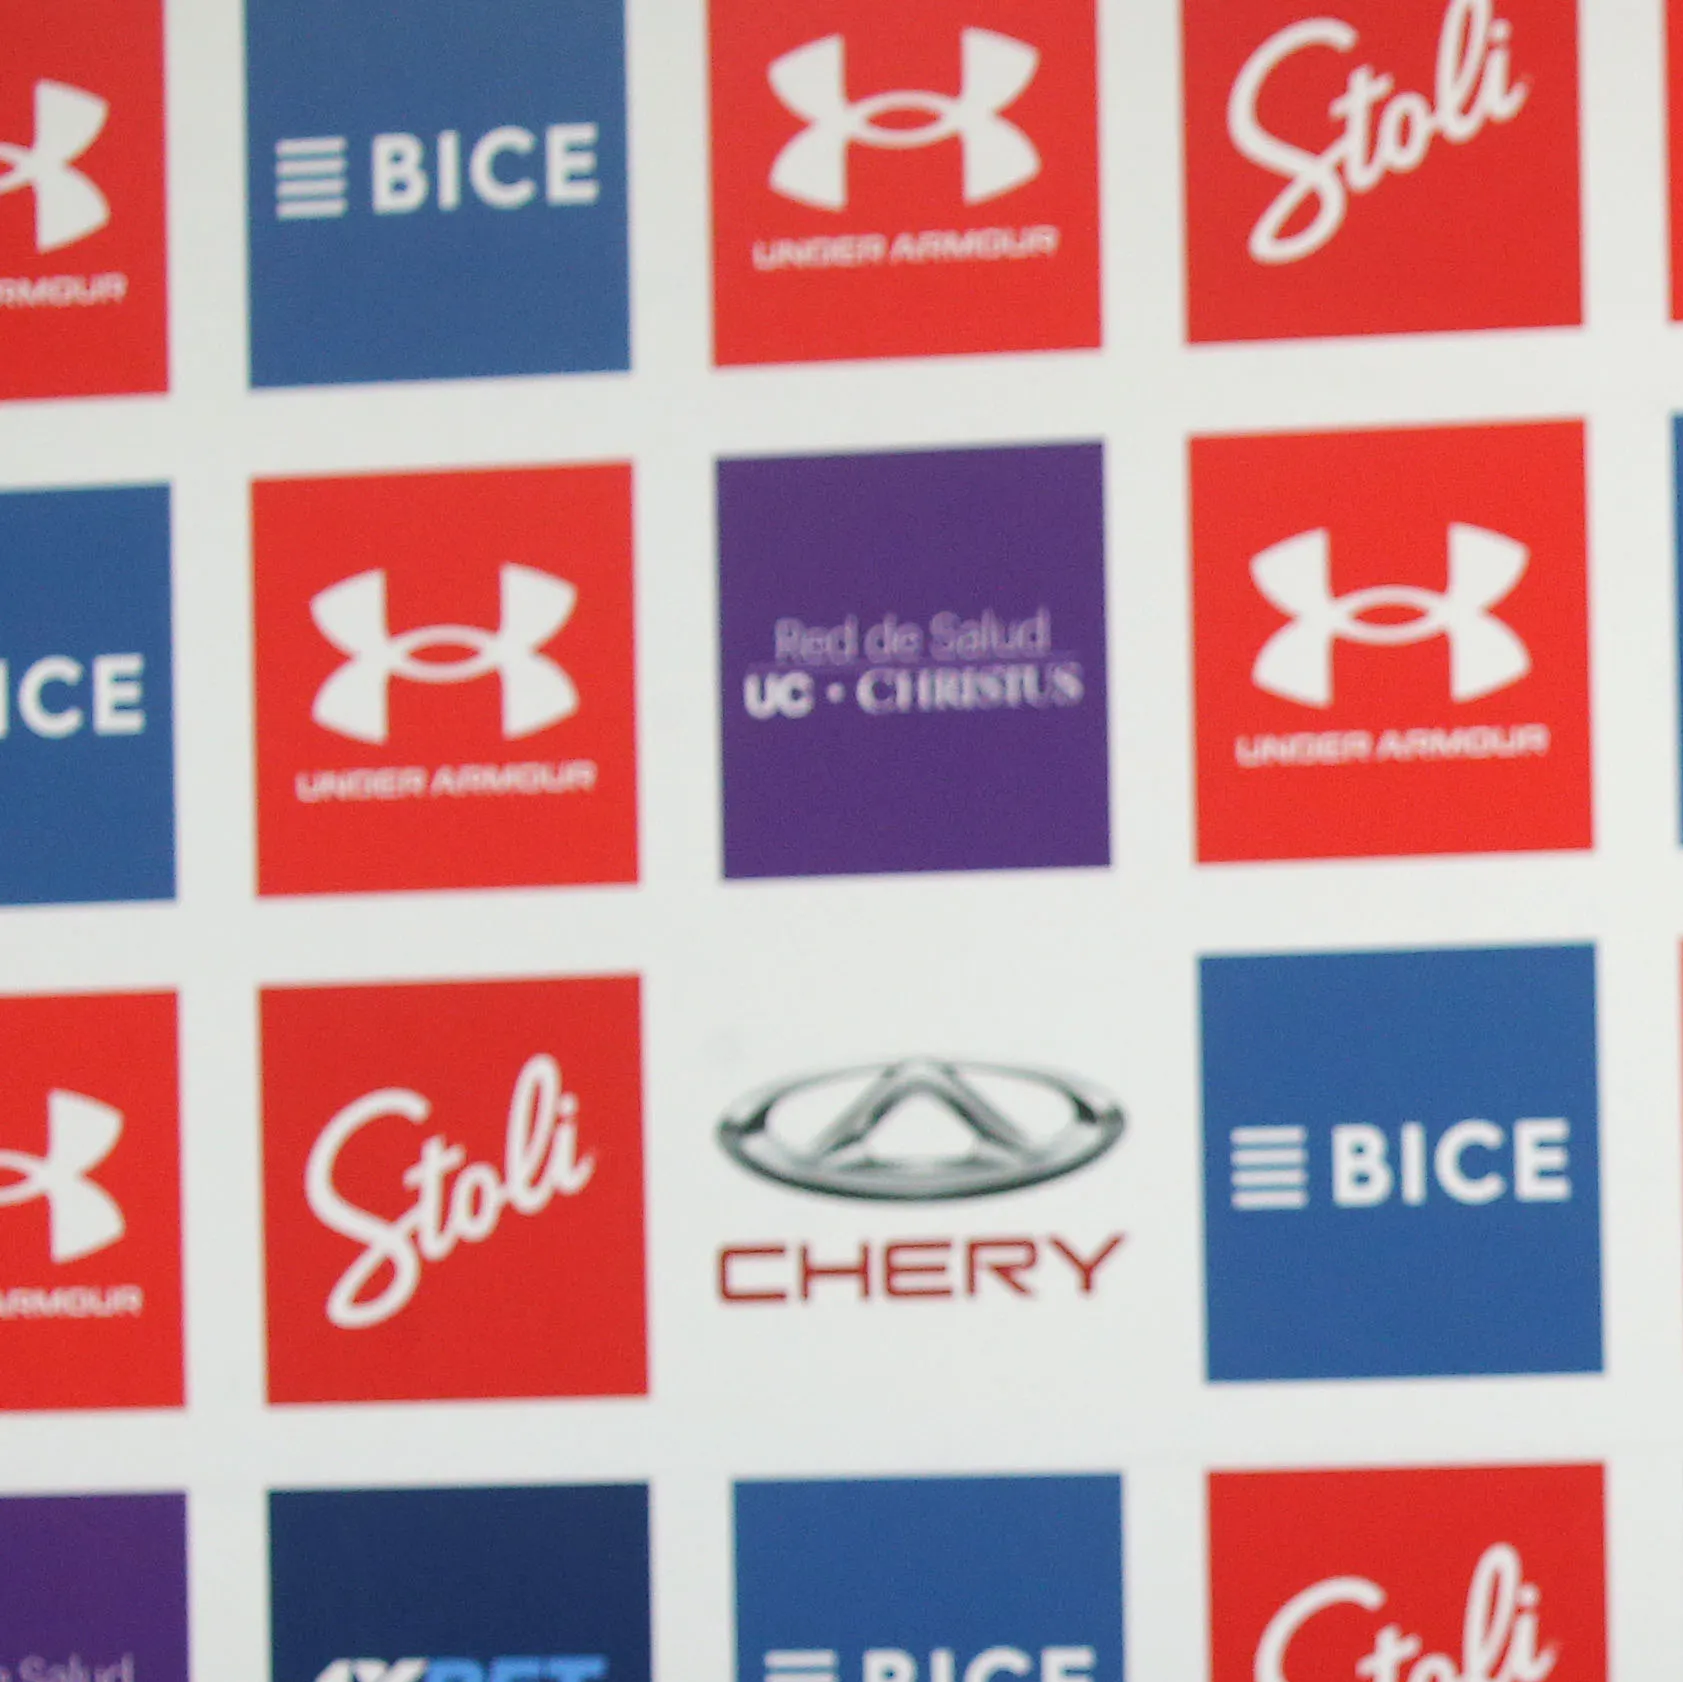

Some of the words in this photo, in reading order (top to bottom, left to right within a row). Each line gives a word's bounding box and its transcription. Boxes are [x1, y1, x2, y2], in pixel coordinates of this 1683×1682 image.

[1227, 0, 1527, 263] Stoli
[372, 123, 601, 215] BICE
[752, 234, 888, 270] UNDER
[888, 225, 1059, 261] ARMOUR
[773, 612, 860, 666] Red
[866, 616, 921, 662] de
[930, 607, 1050, 660] Salud
[744, 672, 813, 718] UC
[856, 666, 1083, 713] CHRISTUS
[1235, 730, 1374, 767] UNDER
[1374, 724, 1550, 759] ARMOUR
[295, 767, 429, 802] UNDER
[429, 760, 597, 795] ARMOUR
[305, 1054, 594, 1328] Stoli
[1332, 1118, 1571, 1207] BICE
[717, 1236, 1123, 1304] CHERY
